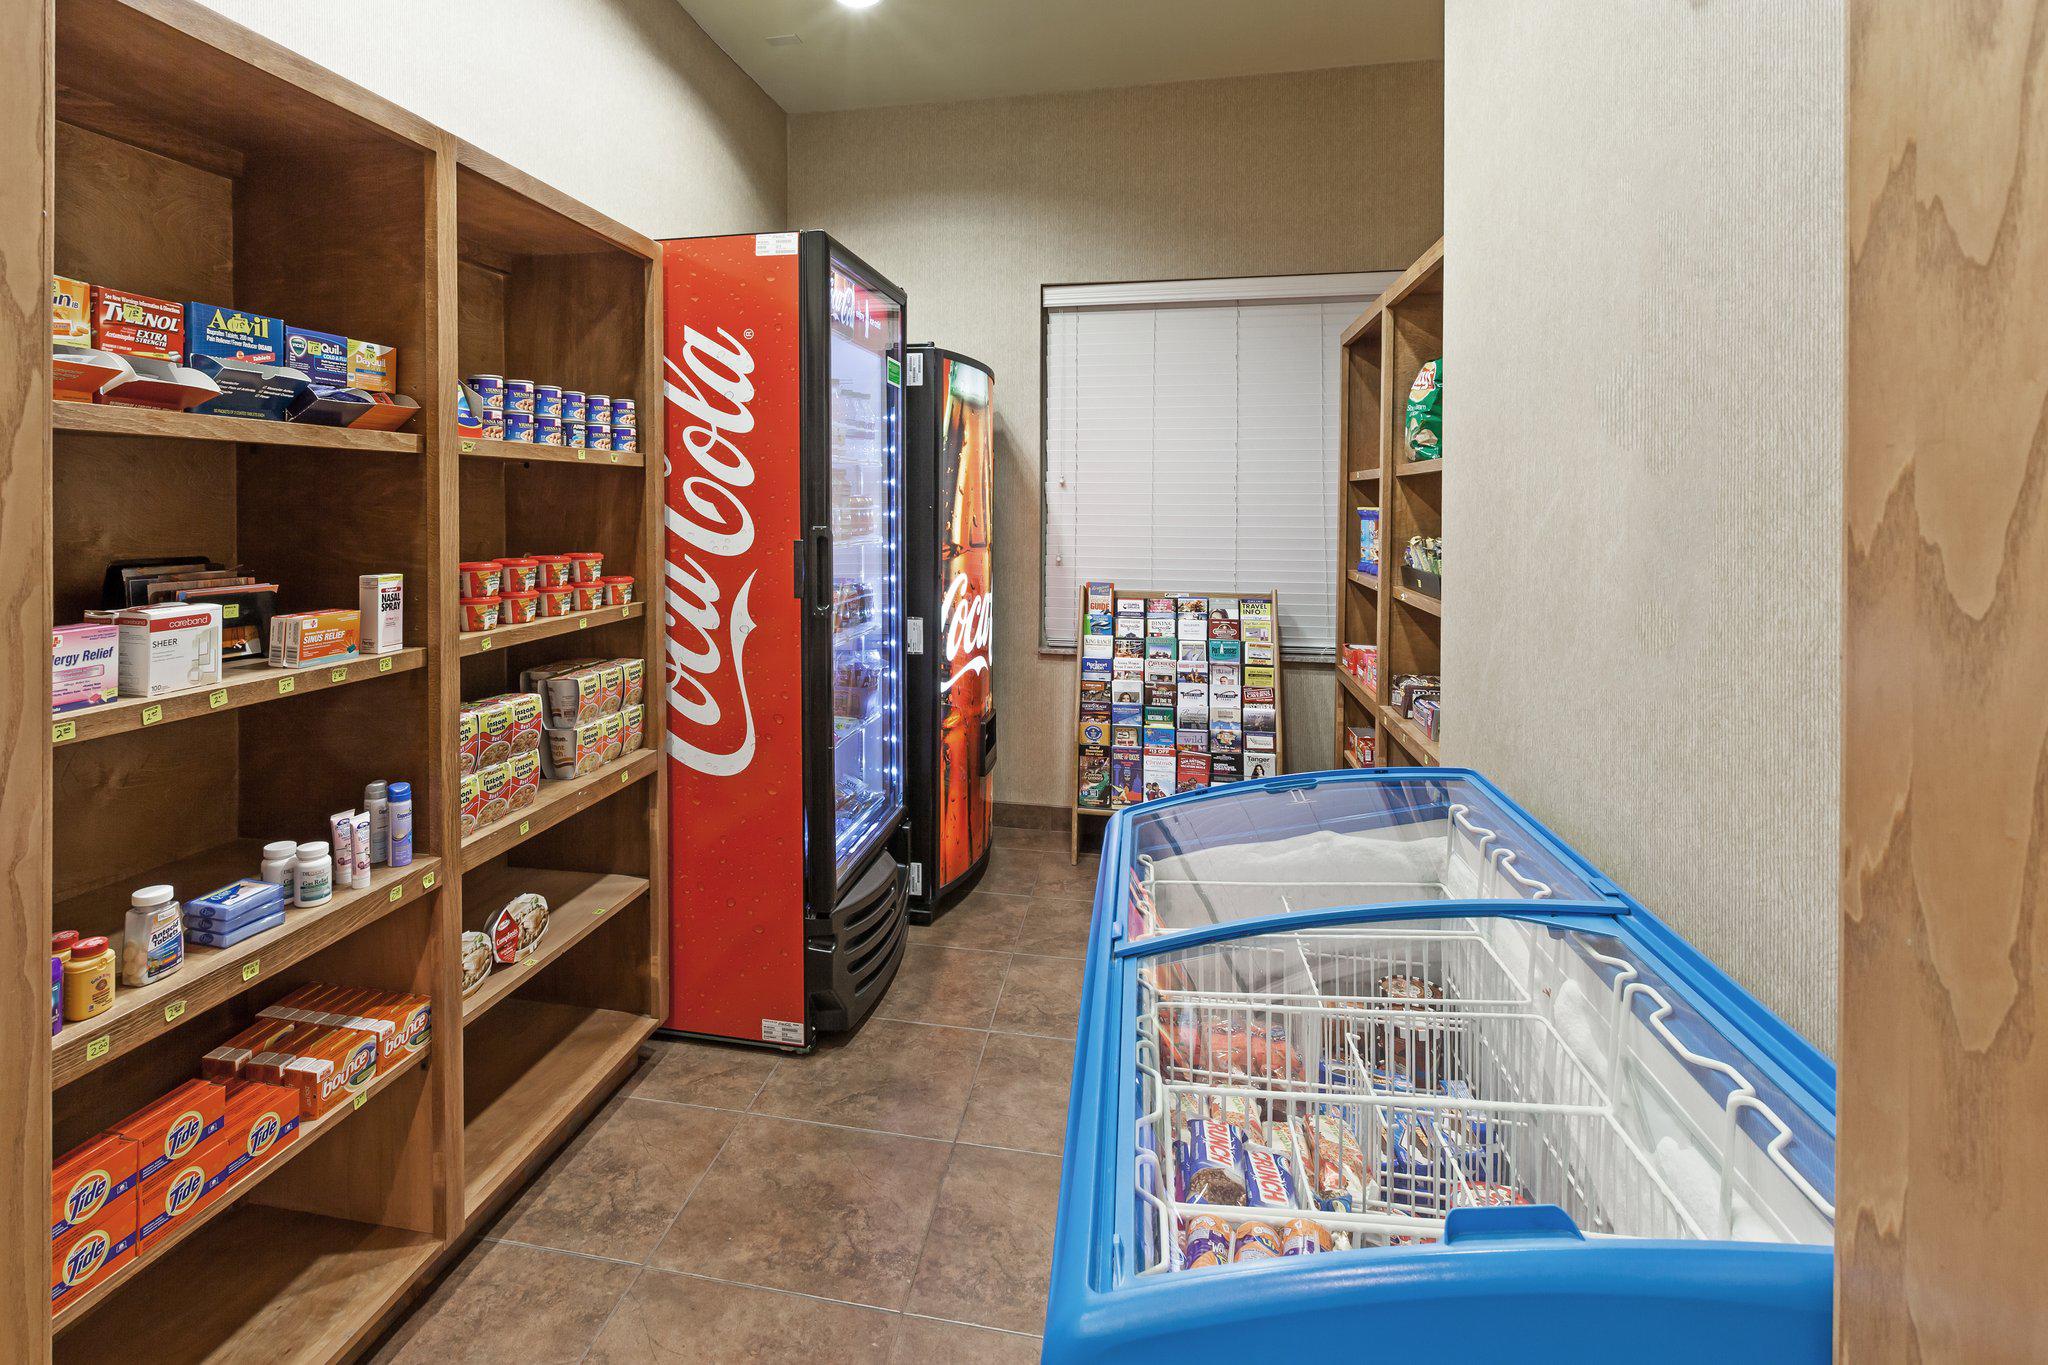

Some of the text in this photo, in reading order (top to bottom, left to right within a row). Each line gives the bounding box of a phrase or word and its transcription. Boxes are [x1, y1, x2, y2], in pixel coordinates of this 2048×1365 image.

[136, 329, 168, 342] EXTRA
[135, 338, 168, 347] STRENGTH
[664, 323, 758, 778] CocaCola
[381, 592, 401, 602] NASAL
[381, 601, 401, 612] SPRAY
[1090, 602, 1110, 610] GUIDE
[168, 616, 208, 629] careband
[152, 638, 178, 648] SHEER
[302, 630, 346, 645] SINUS RELIEF
[52, 646, 114, 667] lergy Relief
[514, 705, 536, 716] Instant
[517, 712, 534, 721] Lunch
[486, 717, 508, 728] Instant
[489, 723, 507, 734] Lunch
[1183, 736, 1204, 744] wild
[1246, 755, 1270, 763] Tanger
[514, 760, 534, 772] Instant
[483, 773, 505, 786] Instant
[516, 768, 532, 778] Lunch
[486, 781, 503, 792] Lunch
[151, 920, 179, 942] Antacid
[153, 928, 178, 947] Tablets
[385, 1012, 427, 1059] bounce
[321, 1050, 368, 1101] bounce
[168, 1118, 200, 1157] Tide
[250, 1119, 277, 1155] Tide
[1251, 1150, 1288, 1205] CRUNCH
[69, 1179, 105, 1221] Tide
[169, 1174, 200, 1214] Tide
[67, 1239, 105, 1283] Tide
